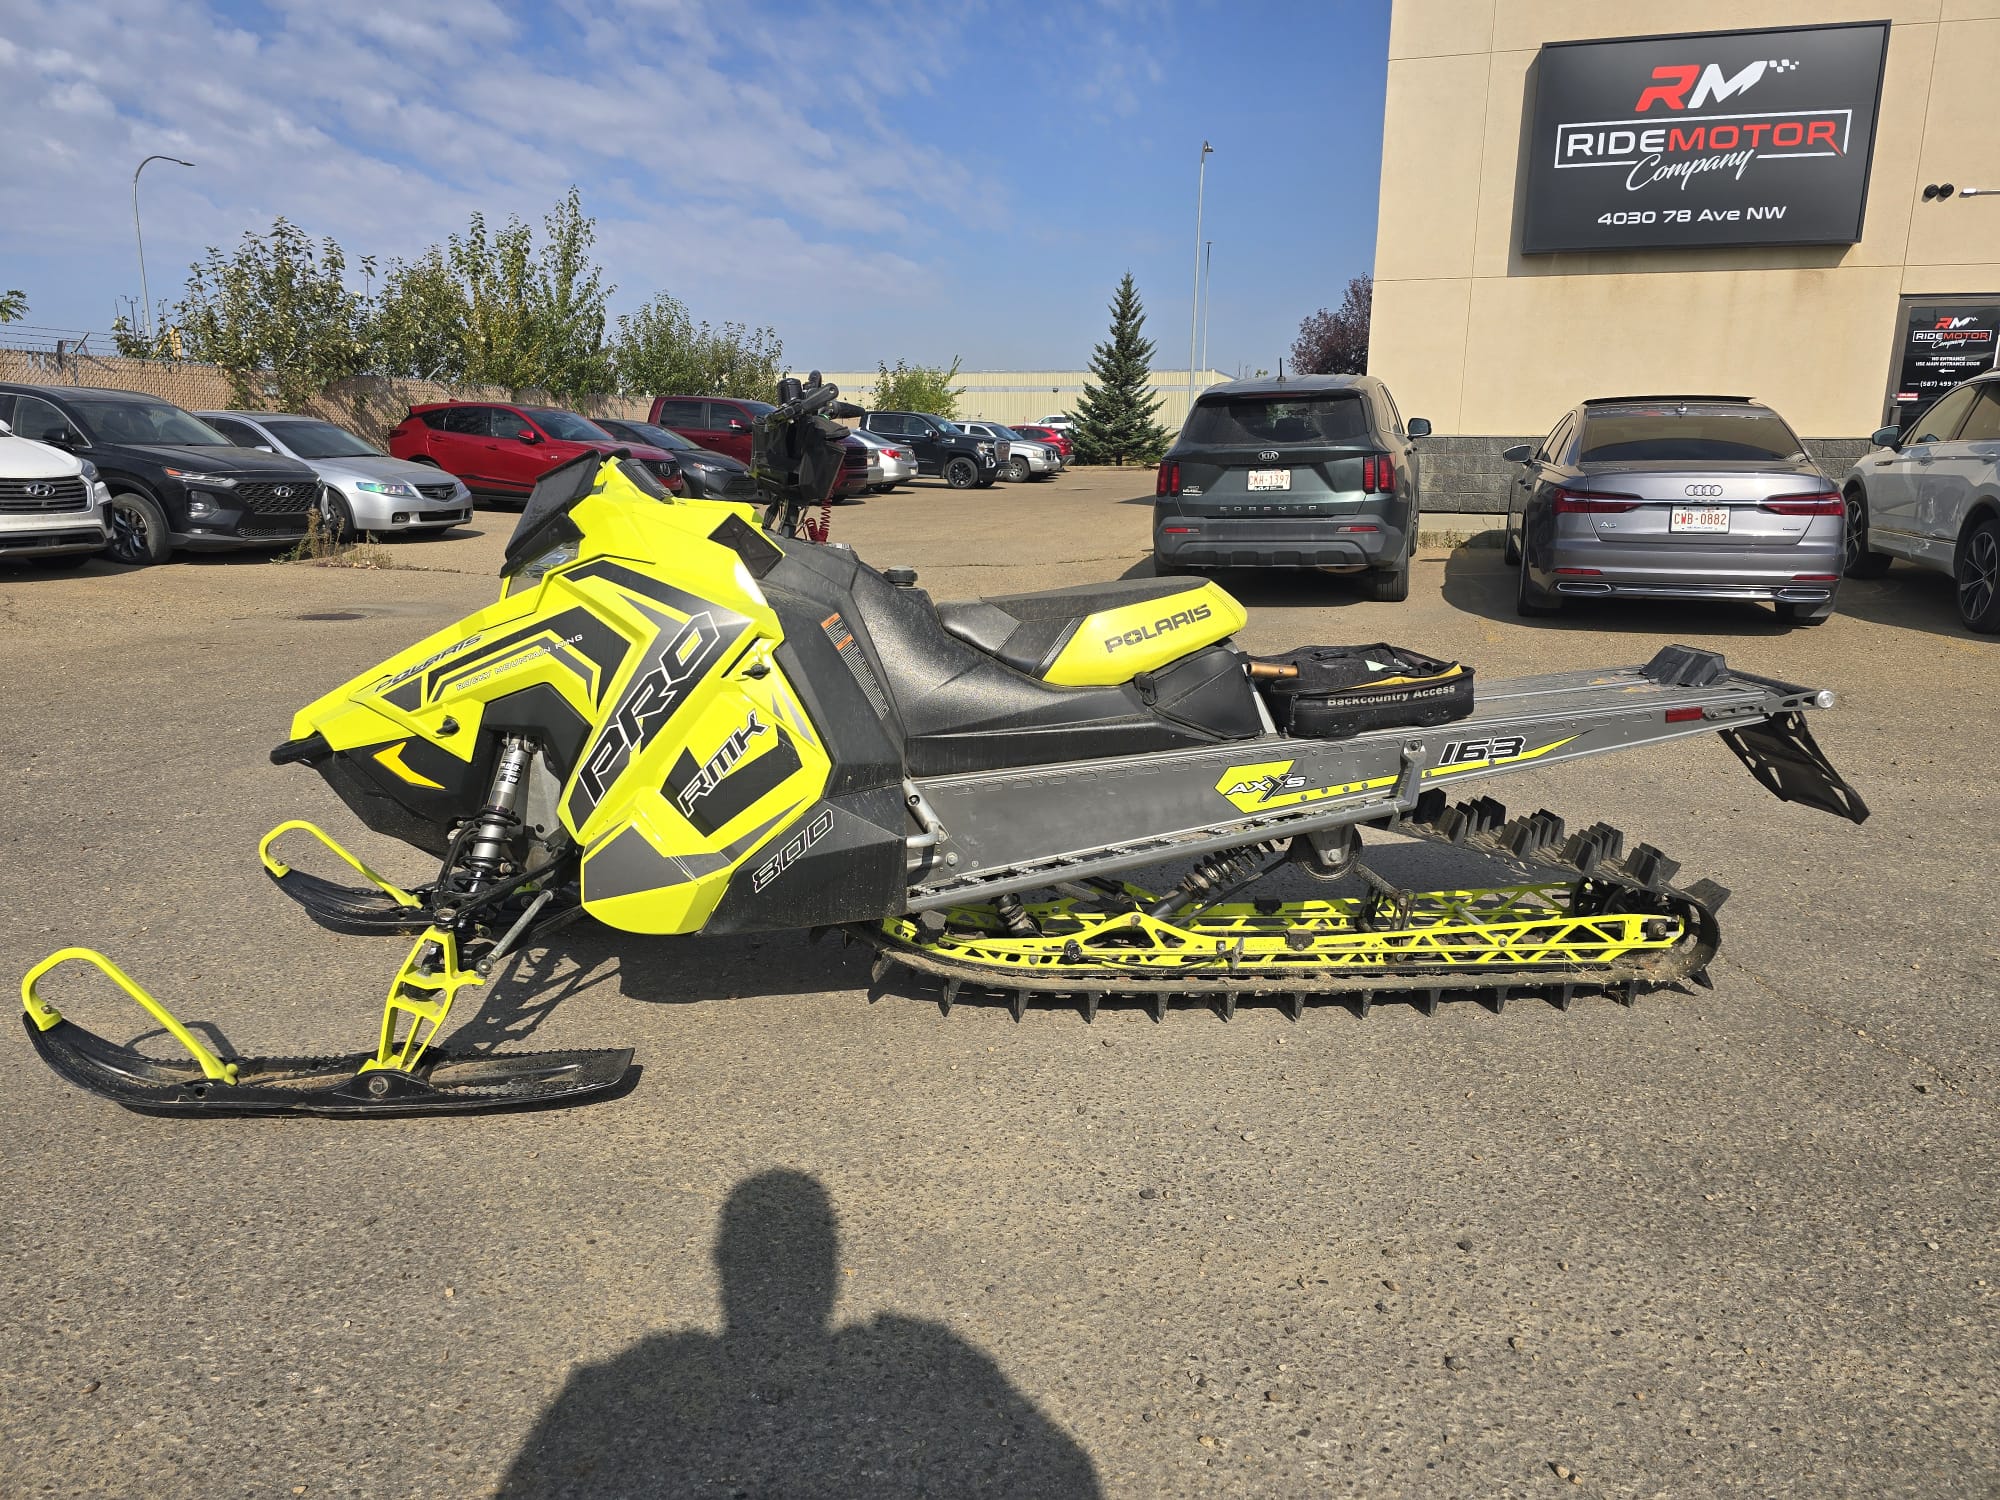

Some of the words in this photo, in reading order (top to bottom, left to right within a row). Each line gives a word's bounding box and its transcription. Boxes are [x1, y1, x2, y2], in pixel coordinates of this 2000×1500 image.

[1635, 60, 1768, 112] RM
[1626, 148, 1754, 191] Company
[1597, 211, 1656, 226] 4030
[1662, 210, 1691, 225] 78
[1697, 208, 1740, 222] Ave
[1746, 206, 1787, 221] NW
[1935, 317, 1971, 329] RM
[1261, 451, 1276, 460] KIA
[1104, 604, 1213, 654] POLARIS
[456, 670, 492, 691] ROCKY
[494, 646, 551, 674] MOUNTAIN
[554, 634, 583, 649] KING
[579, 611, 720, 807] PRO
[1327, 690, 1409, 707] Backcountry
[1413, 684, 1456, 700] Access
[676, 708, 769, 818] RMK
[1437, 735, 1526, 766] 163
[752, 808, 834, 894] 800
